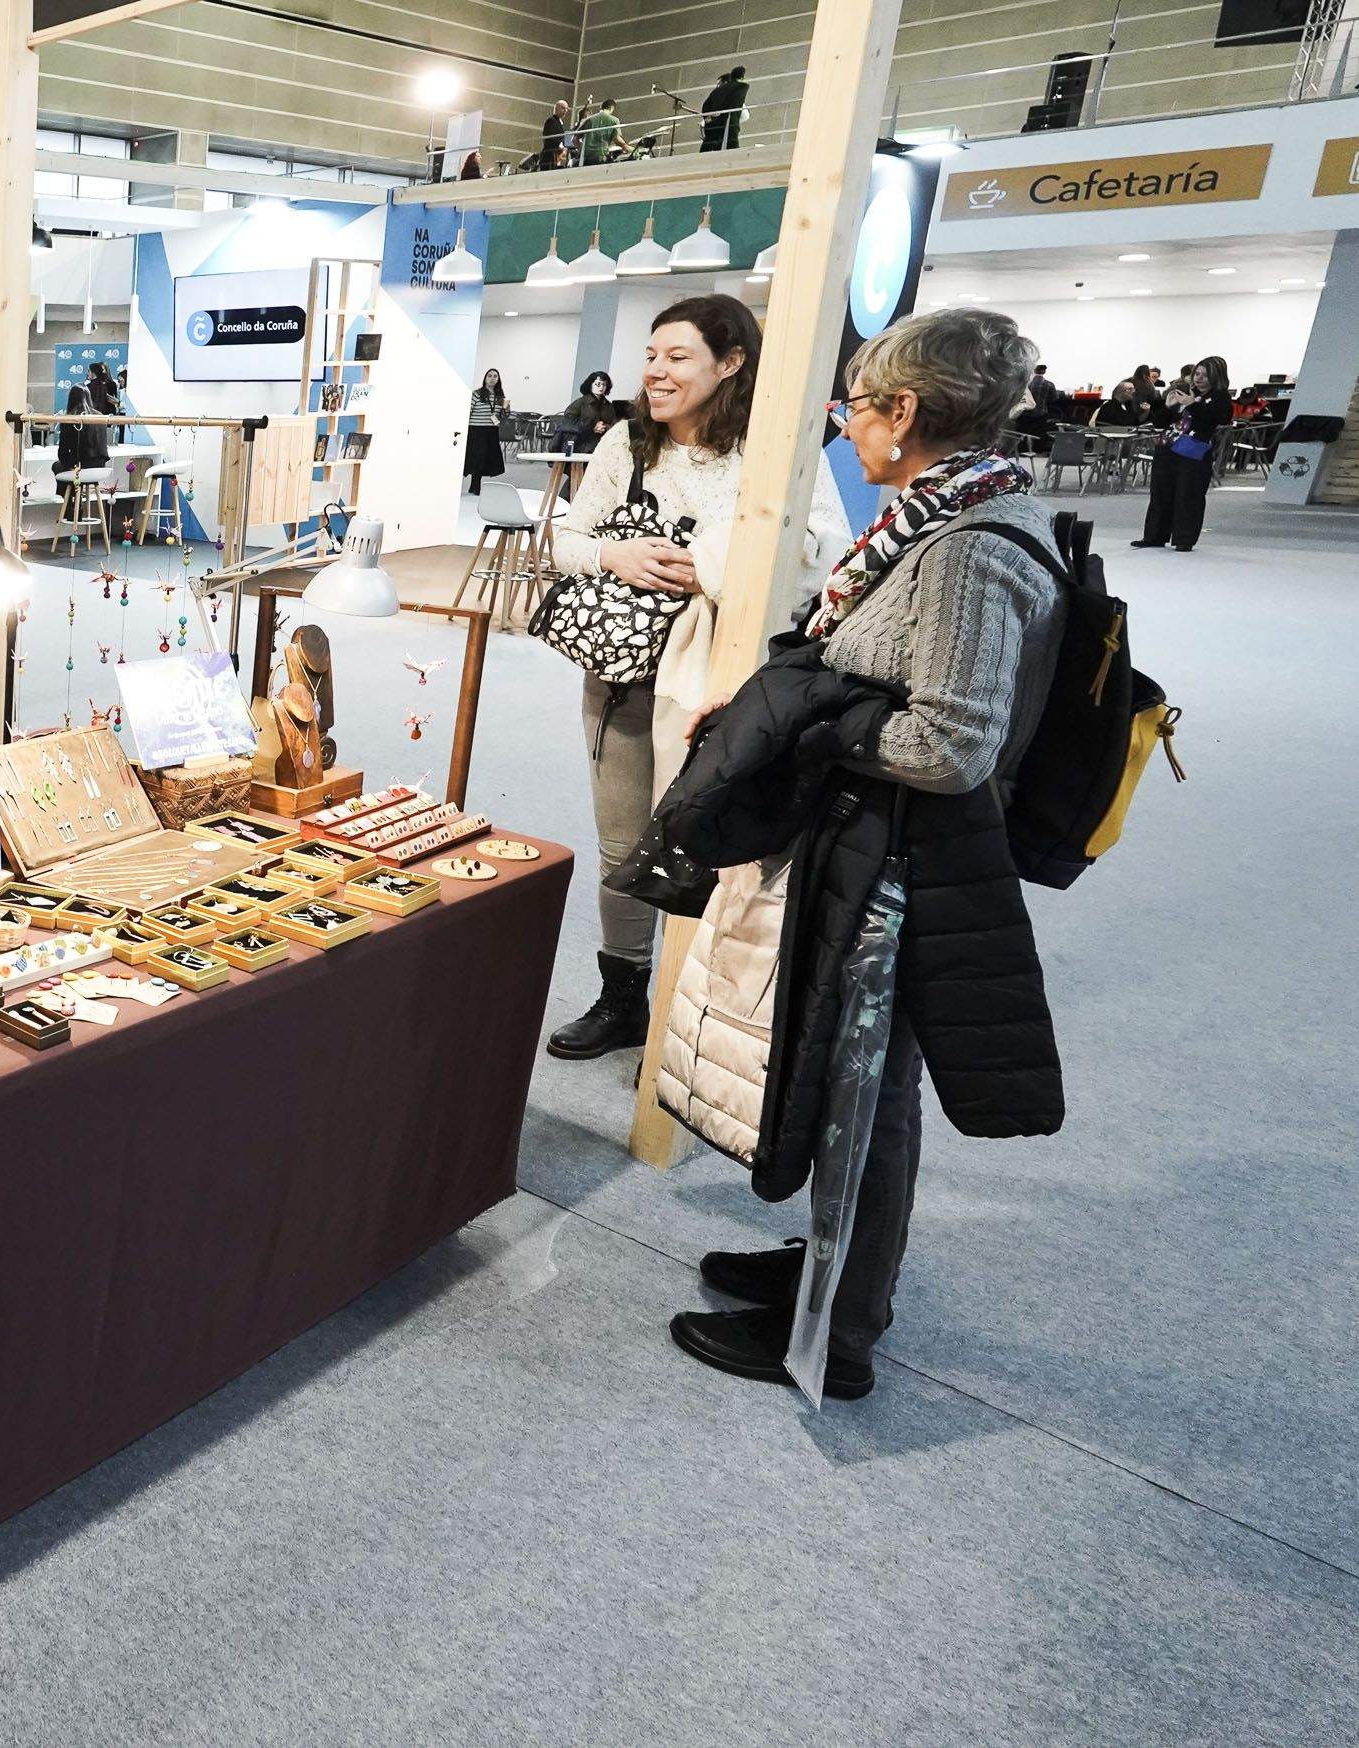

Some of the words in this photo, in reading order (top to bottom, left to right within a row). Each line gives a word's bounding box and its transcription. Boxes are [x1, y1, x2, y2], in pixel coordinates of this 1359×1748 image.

[1029, 161, 1219, 205] Cafetaría
[414, 228, 430, 243] NA
[413, 242, 457, 259] CORUÑ
[217, 321, 253, 334] Concello
[253, 320, 265, 332] da
[266, 319, 299, 332] Coruña
